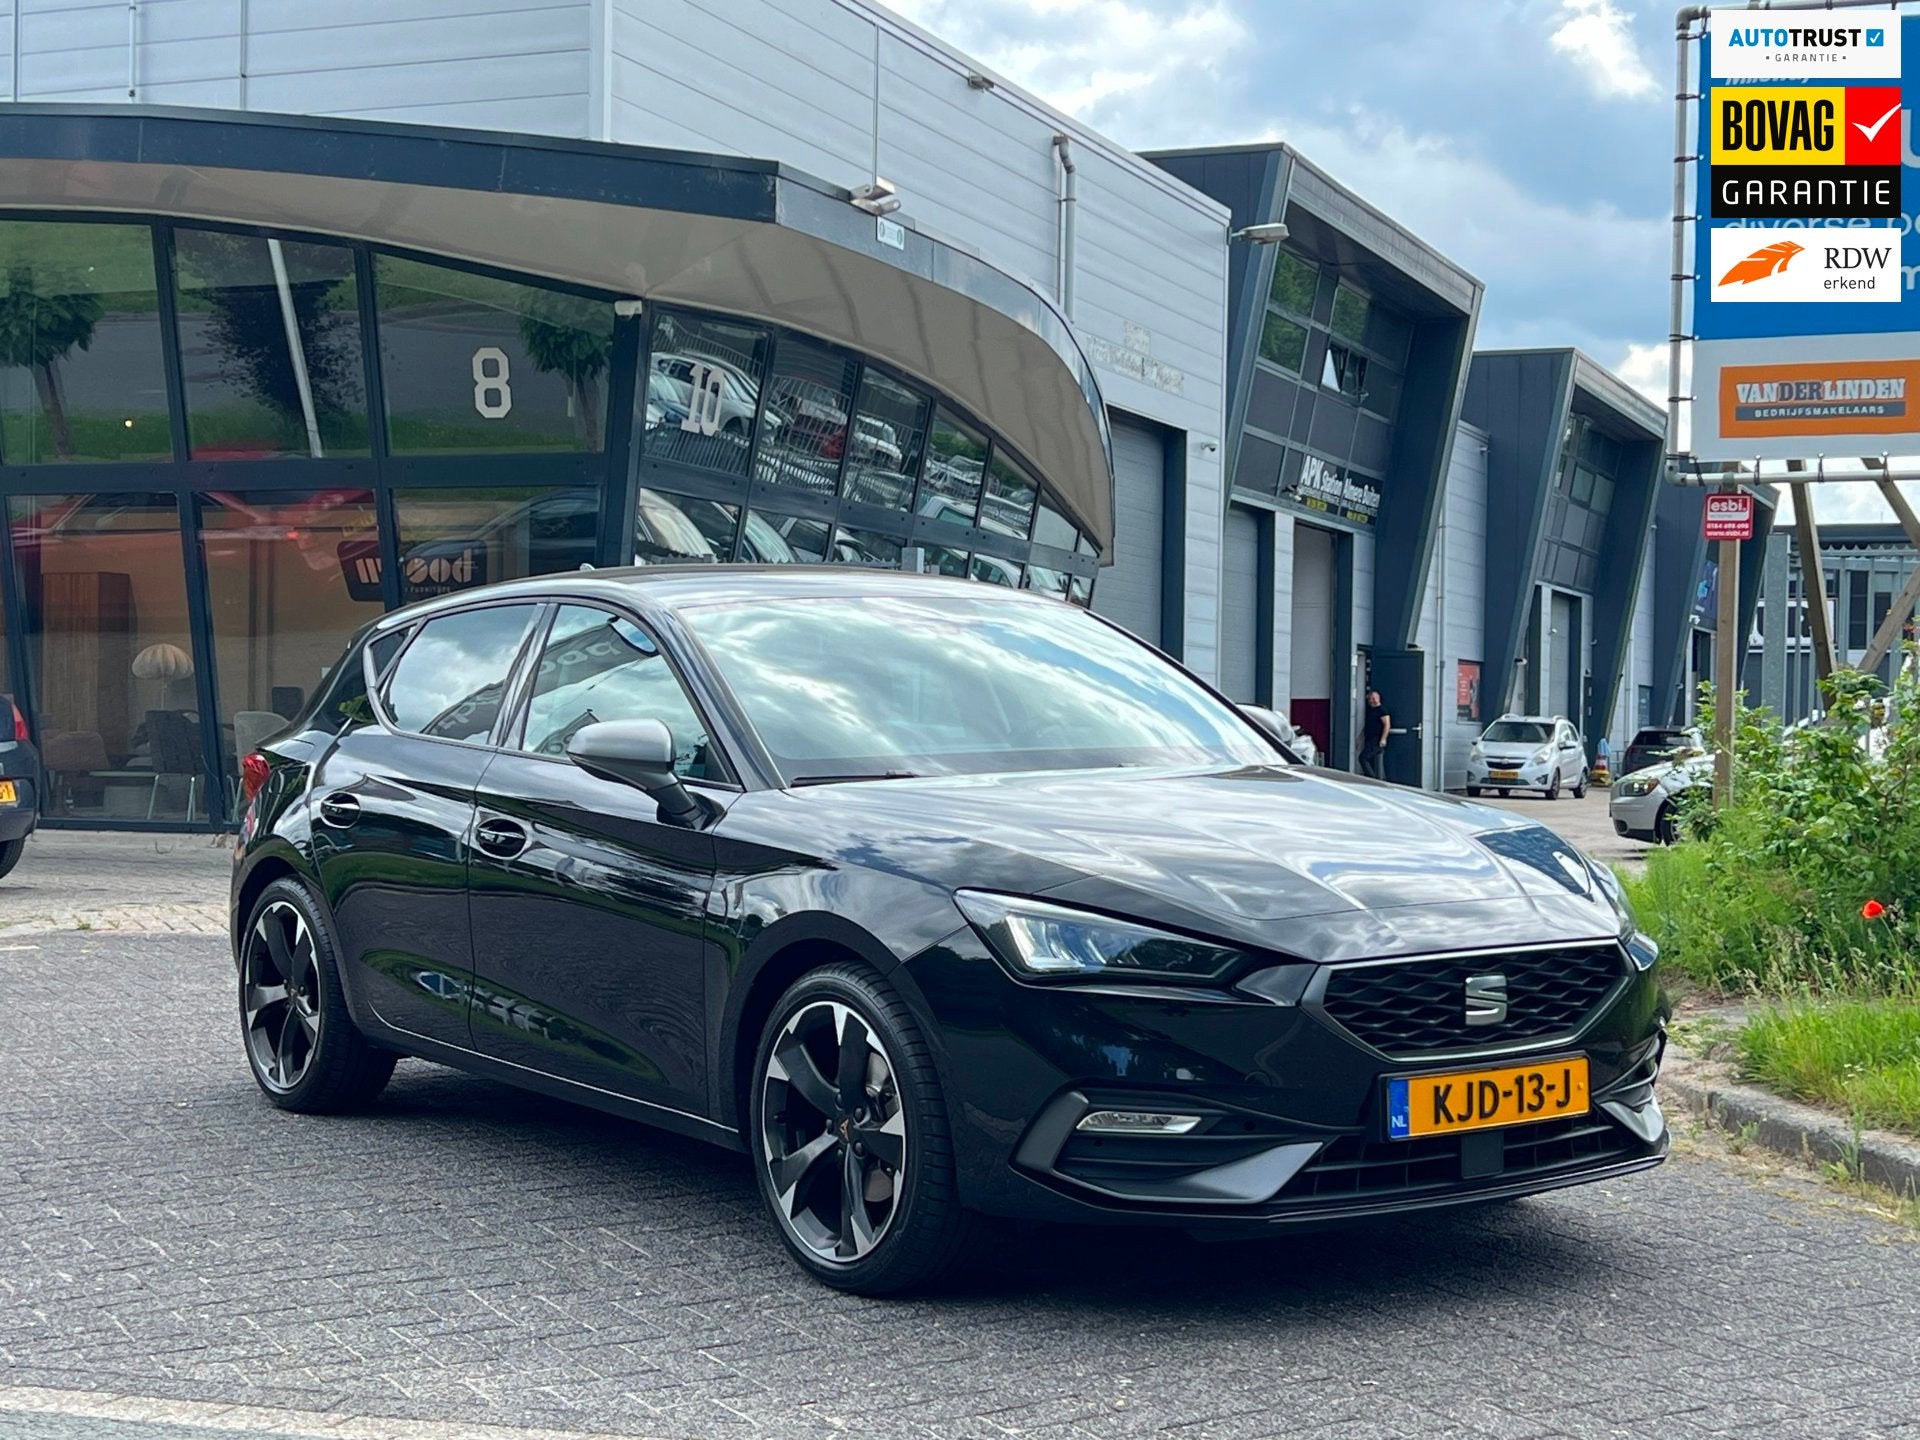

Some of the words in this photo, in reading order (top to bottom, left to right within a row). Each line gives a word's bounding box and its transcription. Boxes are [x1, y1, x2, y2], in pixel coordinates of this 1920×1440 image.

[472, 347, 512, 418] 8
[681, 363, 724, 436] 10
[1754, 405, 1885, 418] BEDRIJFSMAKELAARS
[1300, 455, 1325, 490] APK
[1434, 1069, 1571, 1125] KJD-13-J
[1391, 1116, 1407, 1128] NL
